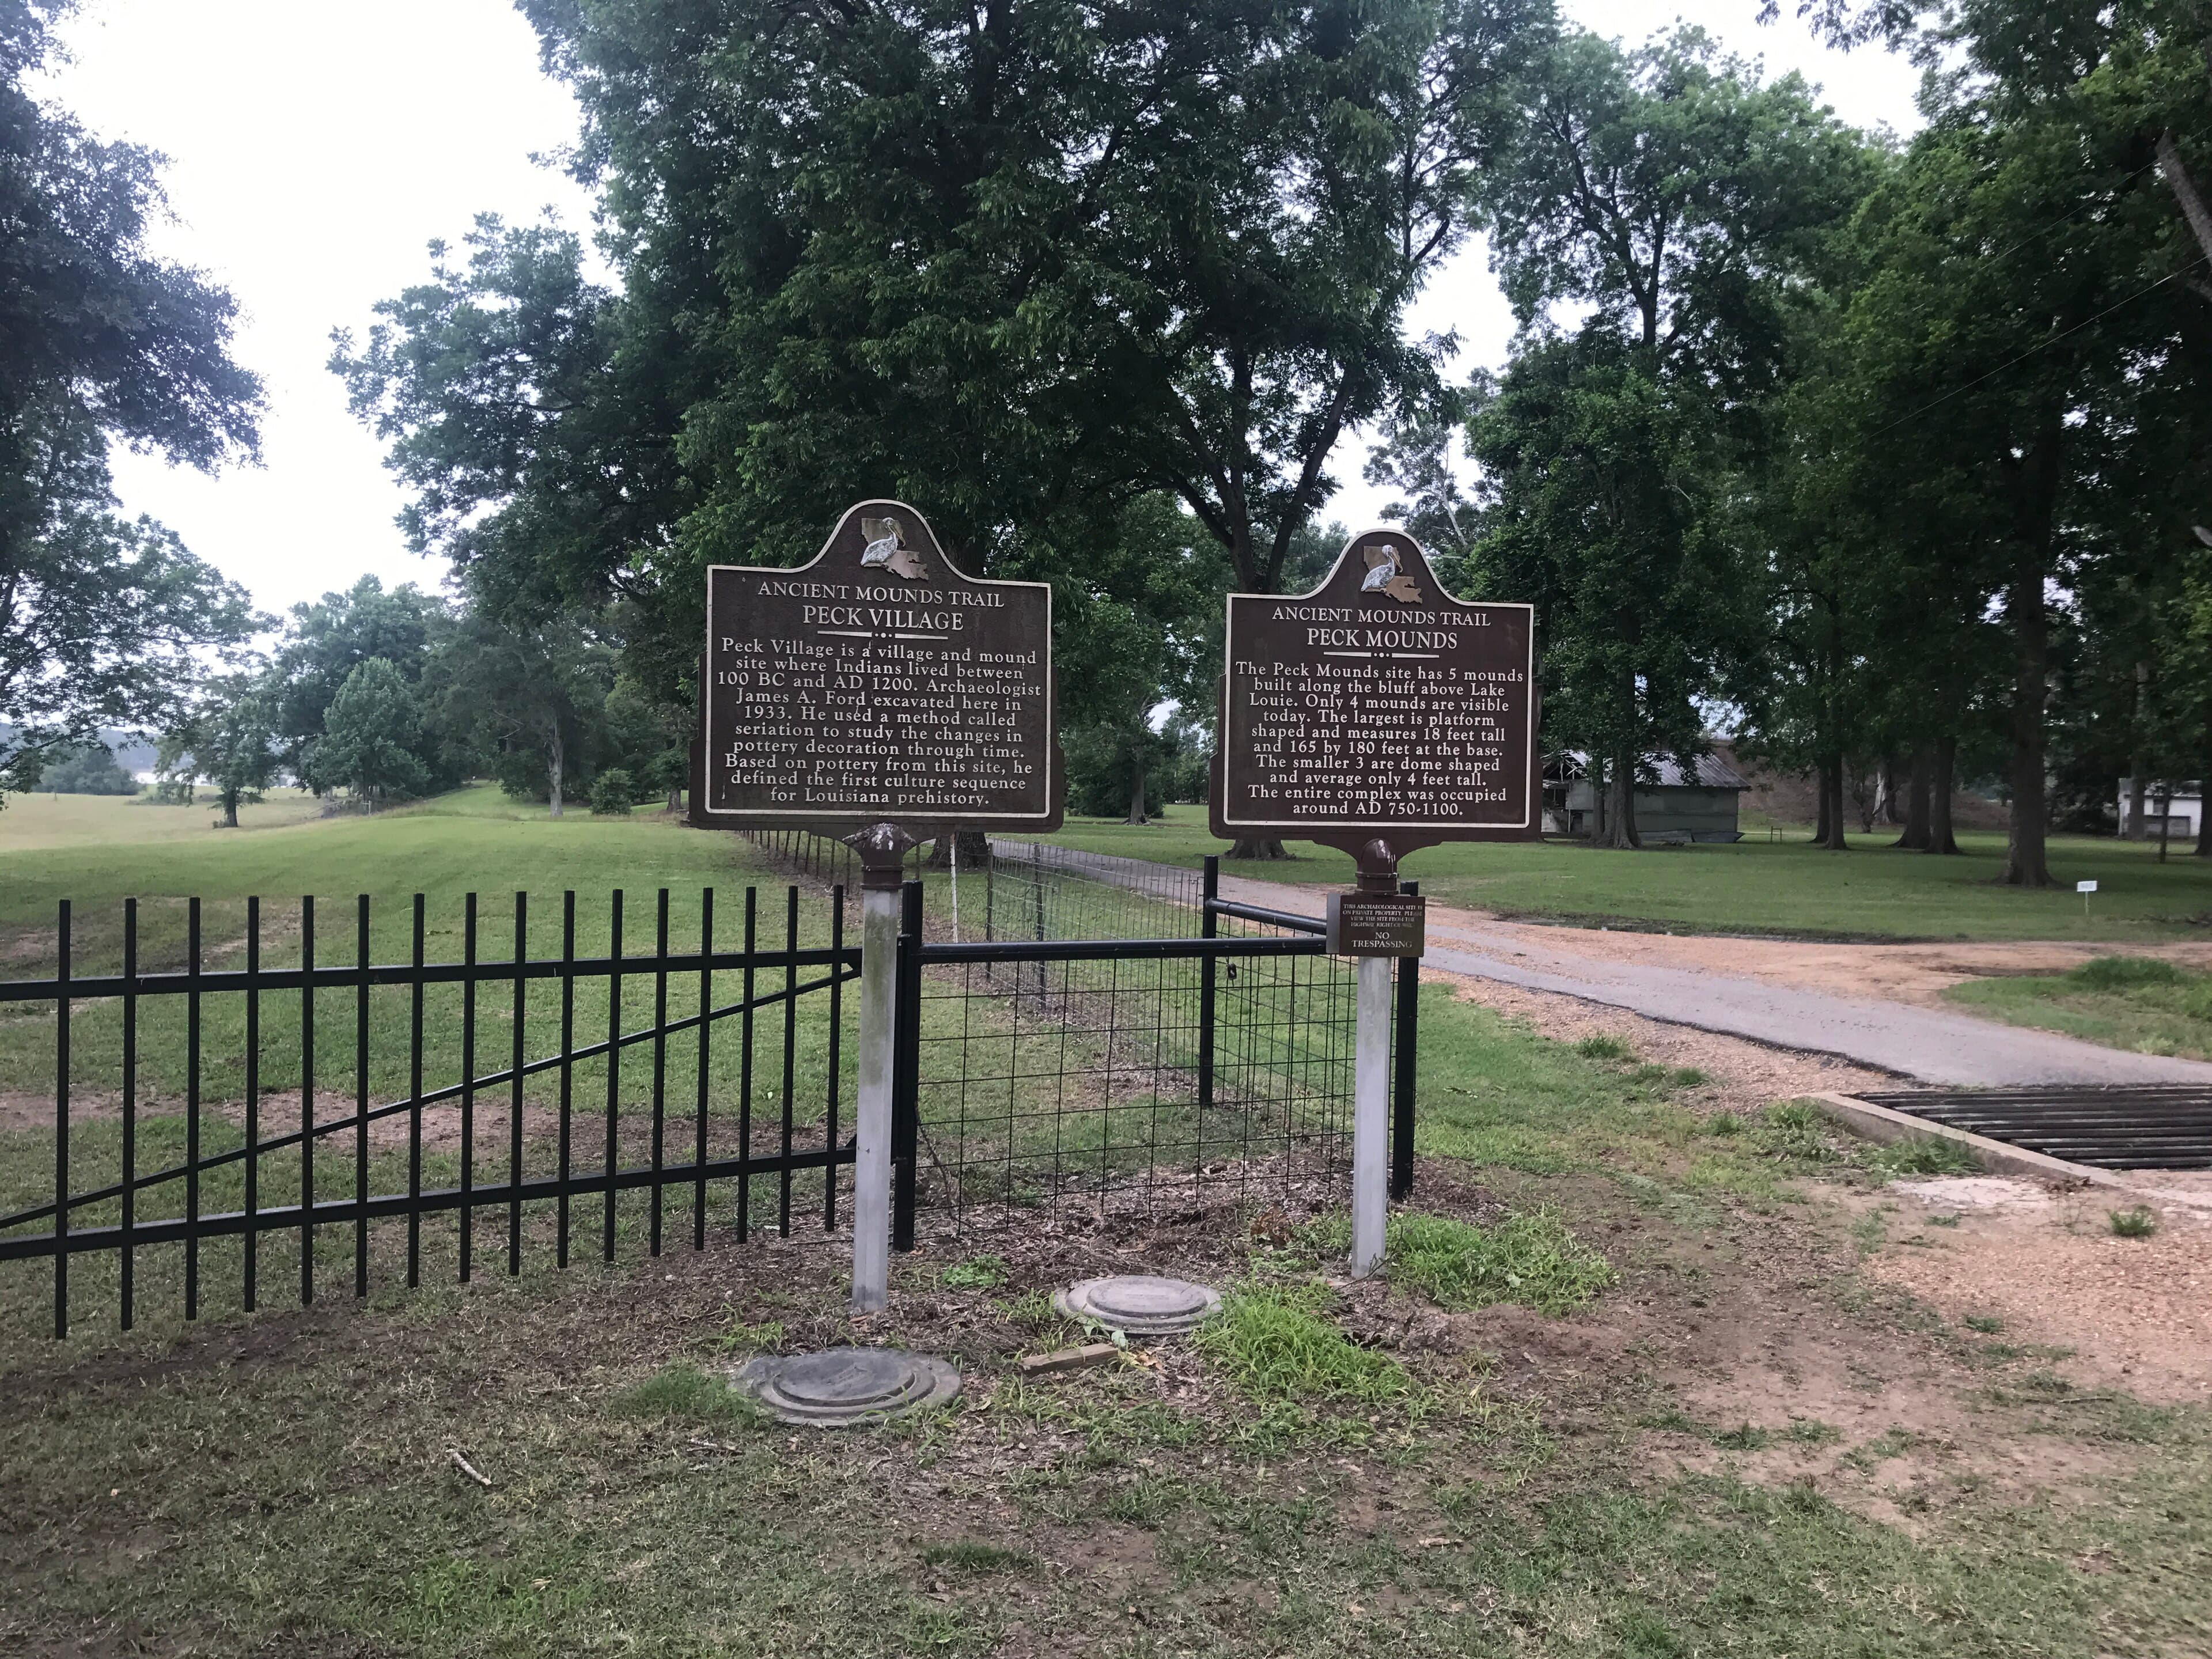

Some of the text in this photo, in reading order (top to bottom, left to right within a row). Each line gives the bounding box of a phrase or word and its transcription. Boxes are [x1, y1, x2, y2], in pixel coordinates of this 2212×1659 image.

[757, 581, 1004, 607] ANCIENT MOUNDS TRAIL
[802, 605, 963, 630] PECK VILLAGE
[1272, 607, 1491, 626] ANCIENT MOUNDS TRAIL
[1306, 628, 1457, 649] PECK MOUNDS
[722, 637, 1036, 664] Peck Village is a village and mound
[736, 655, 1024, 679] site where Indians lived between
[1236, 661, 1523, 682] The Peck Mounds site has 5 mounds
[718, 671, 1041, 698] 100 BC and AD 1200. Archaeologist
[1254, 677, 1505, 696] built along the bluff above Lake
[736, 687, 1021, 710] James A. Ford excavated here in
[1249, 692, 1509, 711] Louie. Only 4 mounds are visible
[745, 705, 1016, 726] 1933. He used a method called
[1263, 708, 1495, 728] today. The largest is platform
[736, 722, 1022, 745] seriation to study the changes in
[1252, 723, 1505, 741] shaped and measures 18 feet tall
[733, 738, 1024, 759] pottery decoration through time.
[1253, 740, 1502, 756] and 165 by 180 feet at the base.
[725, 753, 1032, 777] Based on pottery from this site, he
[1256, 754, 1499, 771] The smaller 3 are dome shaped
[731, 769, 1025, 791] defined the first culture sequence
[1270, 770, 1486, 787] and average only 4 feet tall.
[771, 786, 989, 806] for Louisiana prehistory.
[1248, 784, 1506, 803] The entire complex was occupied
[1293, 801, 1463, 816] around AD 750-1100.
